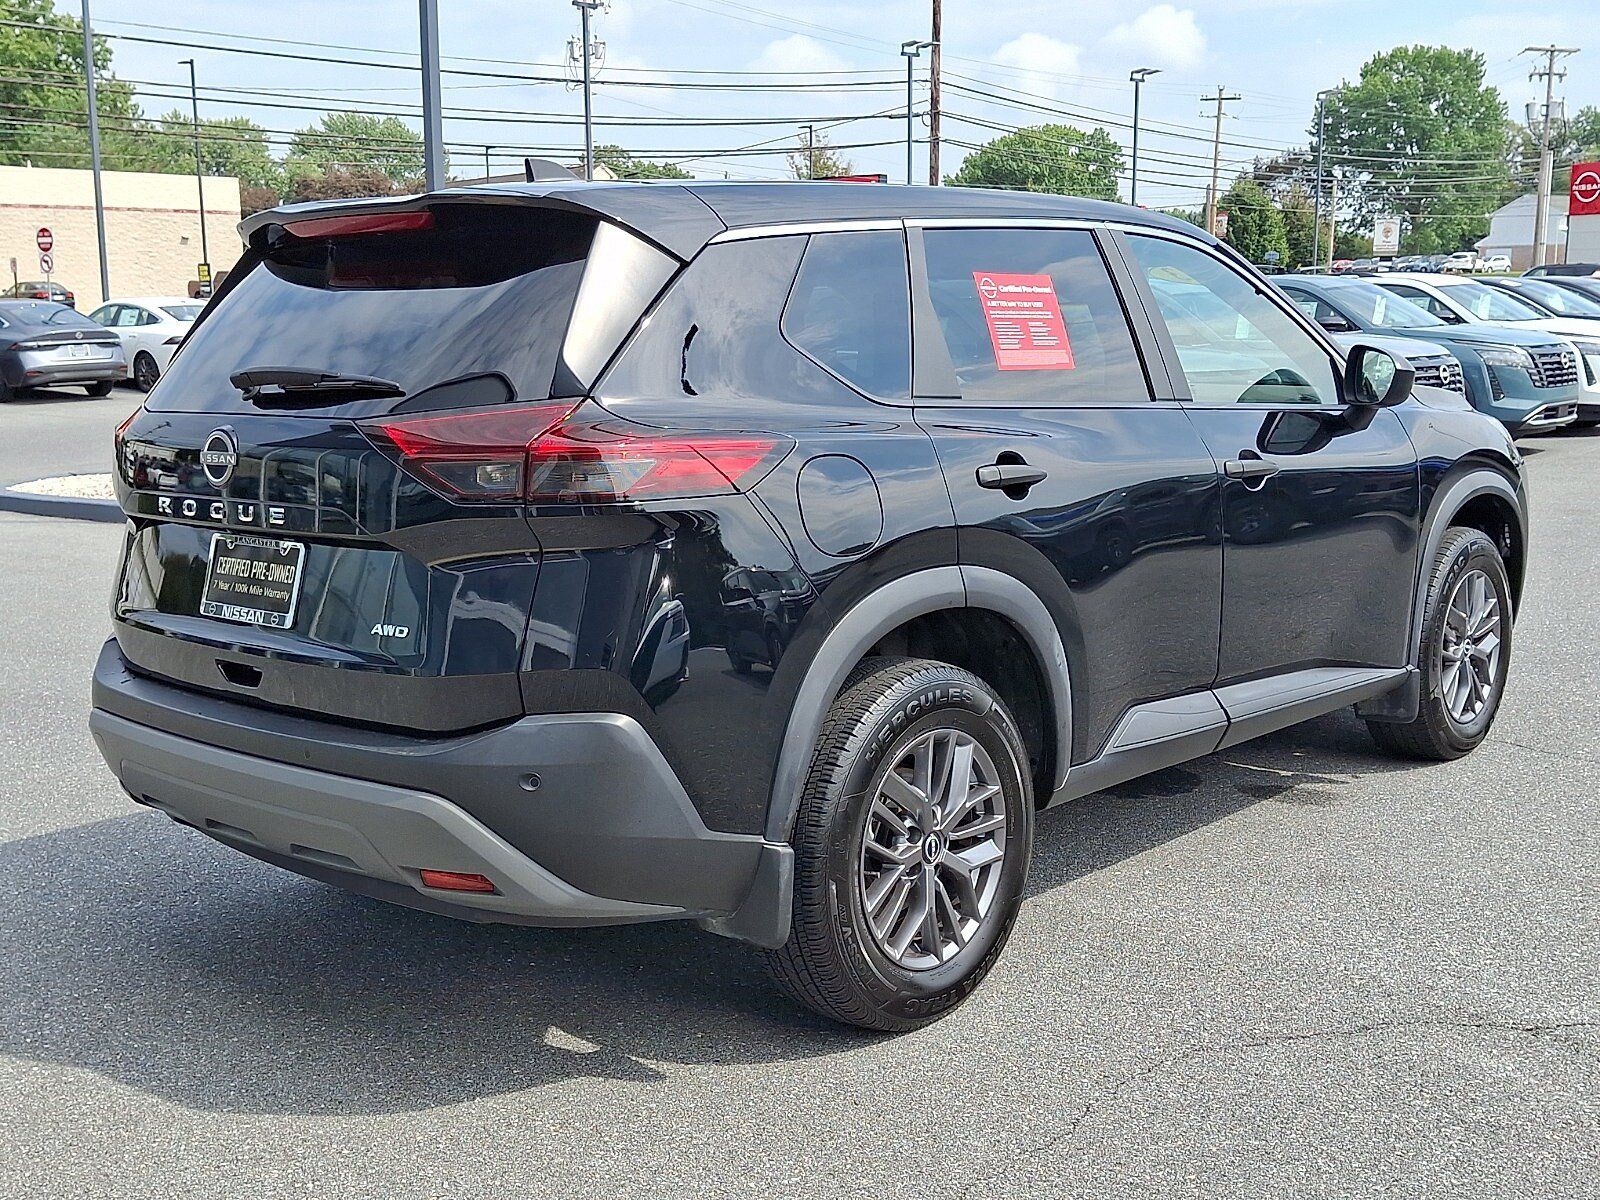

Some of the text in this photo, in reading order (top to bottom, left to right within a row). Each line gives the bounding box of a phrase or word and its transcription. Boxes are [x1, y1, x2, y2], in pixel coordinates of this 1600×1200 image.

[202, 453, 235, 465] SSAN
[158, 496, 286, 526] ROGUE
[238, 536, 277, 548] LANCASTER
[216, 556, 296, 584] CERTIFIED PRE-OWNED
[213, 580, 218, 588] 7
[218, 579, 230, 591] Year
[235, 583, 248, 594] 100k
[249, 585, 263, 596] Mile
[264, 587, 290, 602] Warranty
[222, 605, 265, 623] NISSAN
[370, 623, 409, 638] AWD
[864, 687, 974, 764] HERCULES
